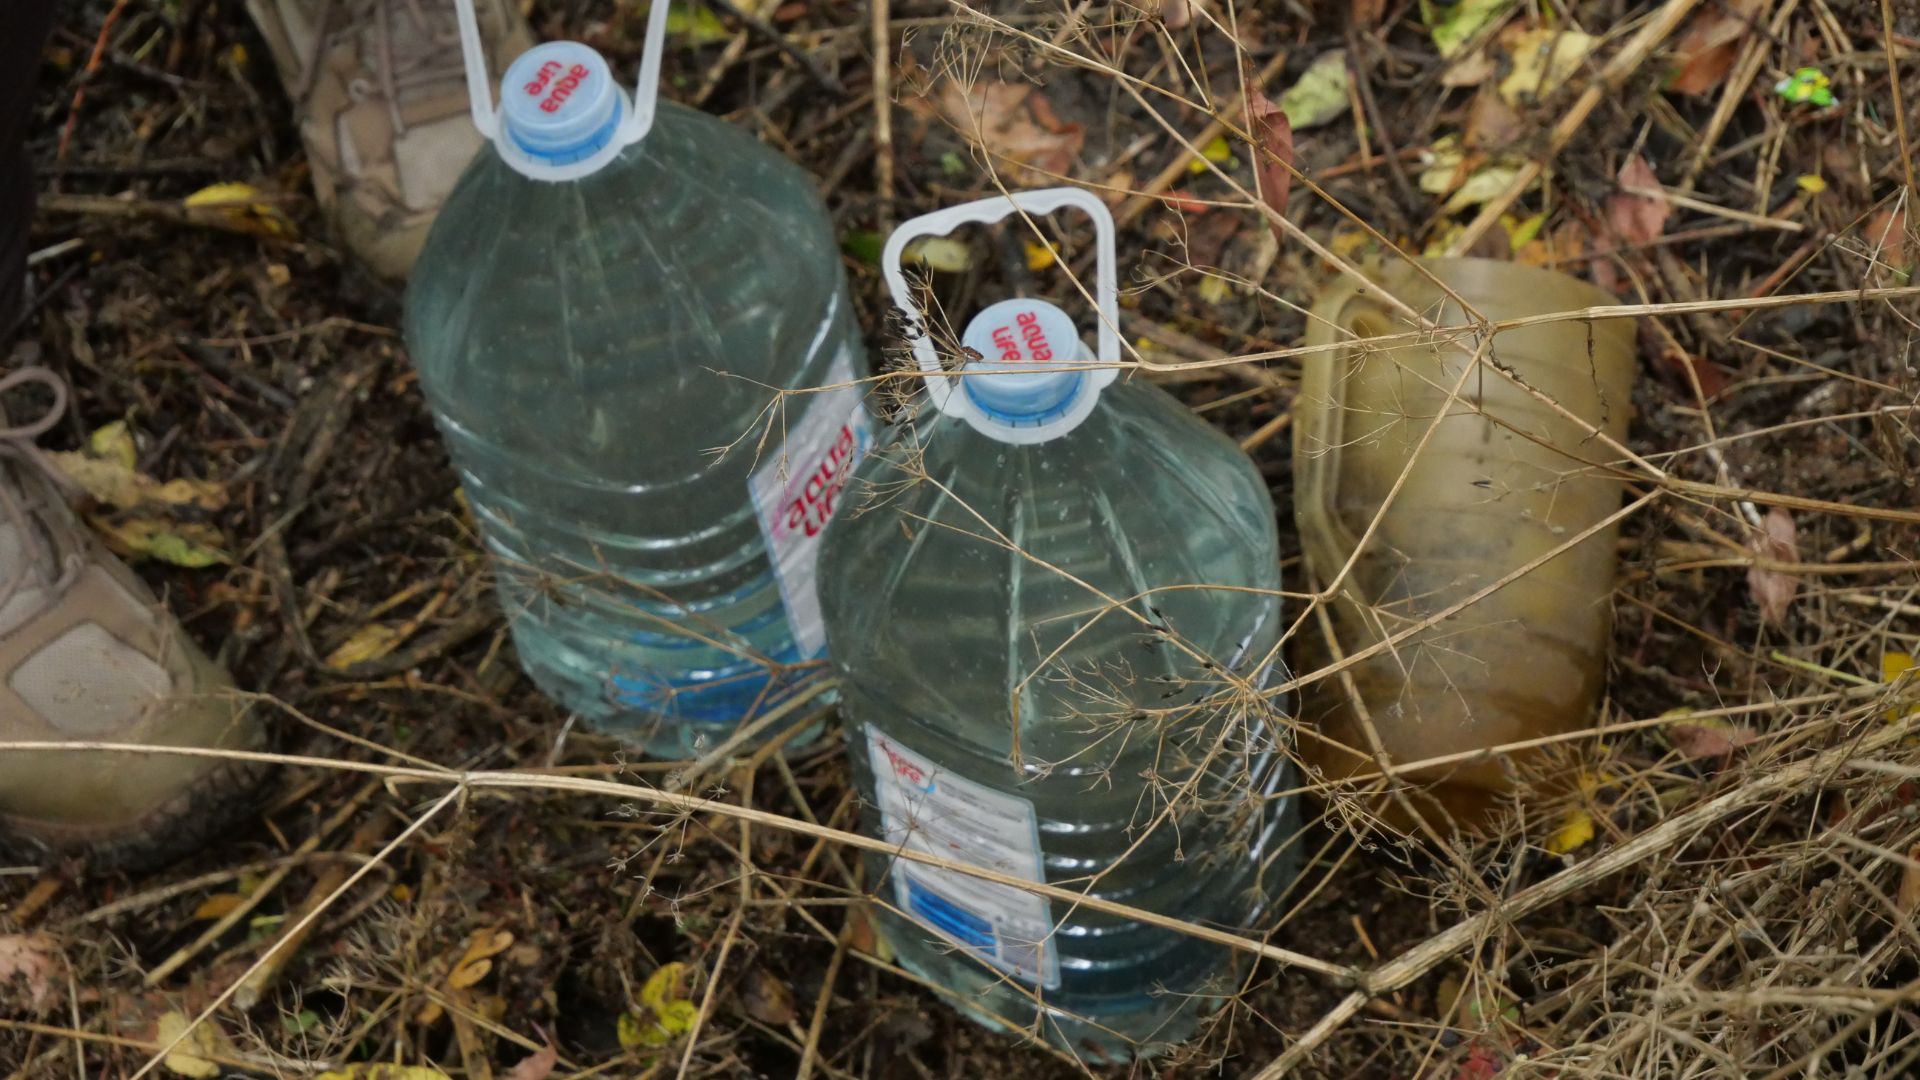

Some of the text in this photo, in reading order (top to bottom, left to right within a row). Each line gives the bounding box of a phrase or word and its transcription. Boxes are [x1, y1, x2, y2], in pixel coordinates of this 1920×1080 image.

[540, 63, 590, 113] aqua
[1016, 311, 1053, 361] aqua
[786, 423, 853, 530] aqua
